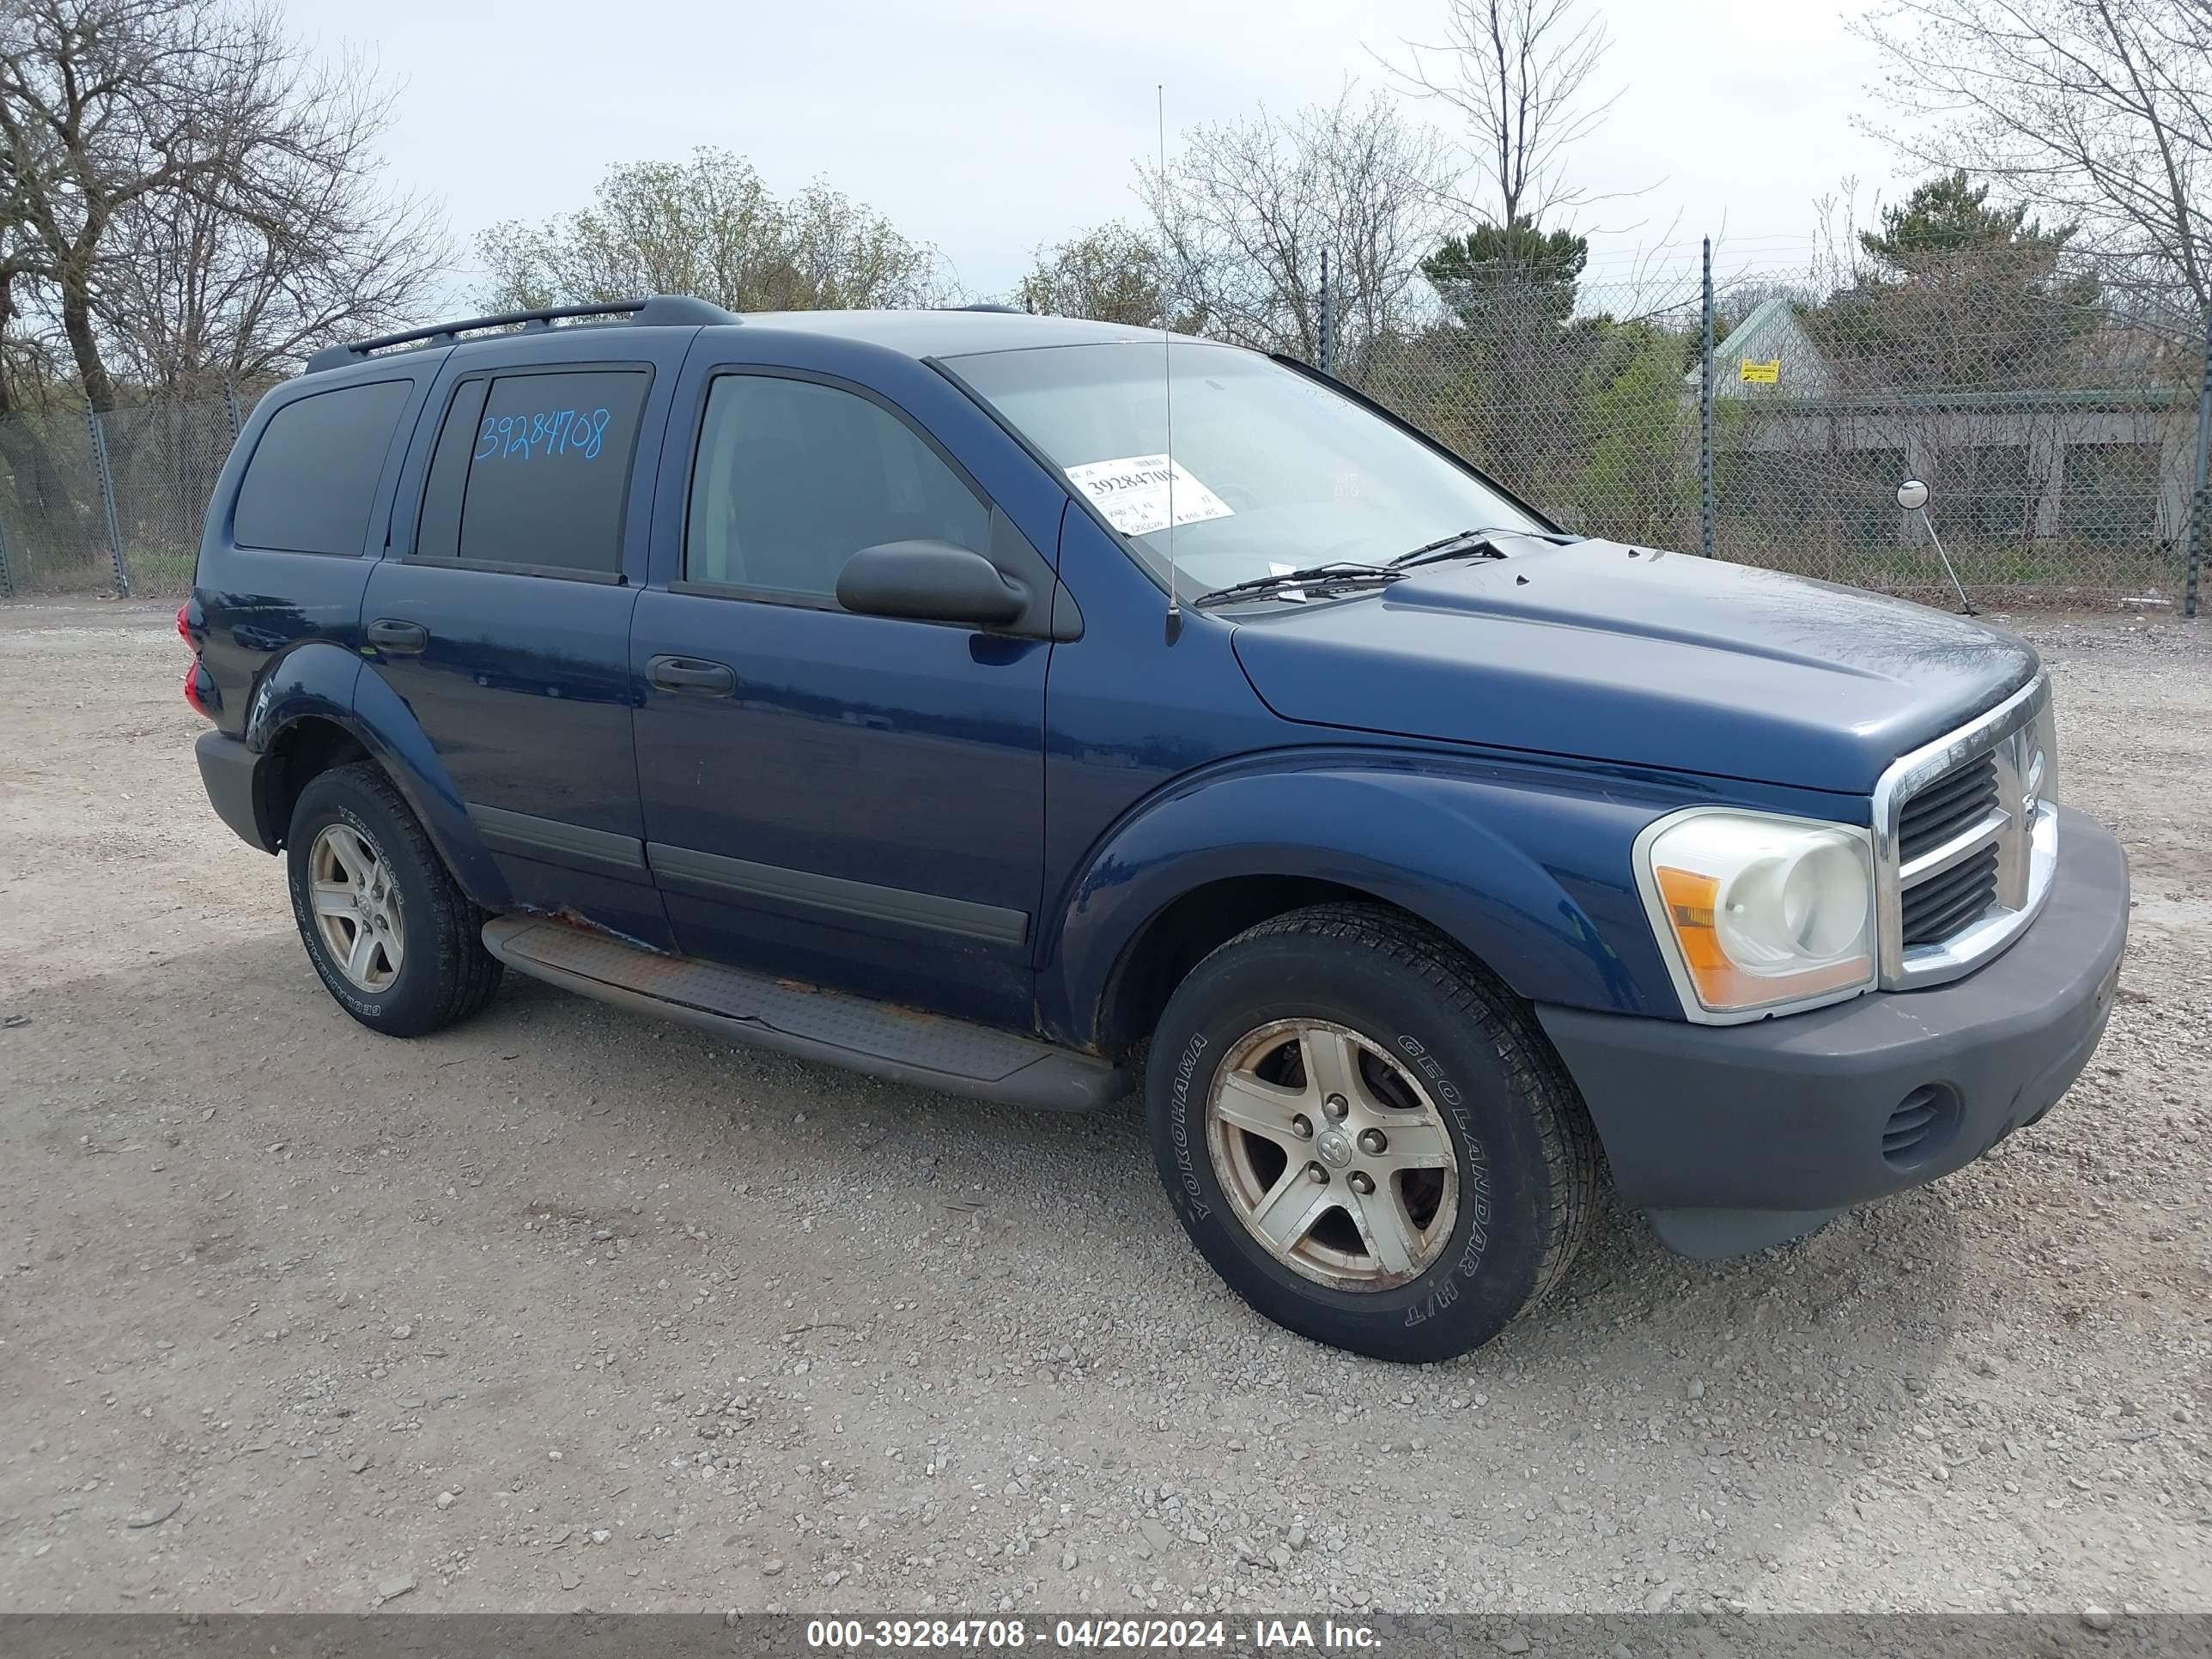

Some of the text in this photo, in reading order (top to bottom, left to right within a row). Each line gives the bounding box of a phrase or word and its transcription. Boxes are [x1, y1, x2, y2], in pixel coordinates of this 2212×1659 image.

[475, 408, 611, 460] 39284708
[1087, 468, 1180, 495] 39284708
[1169, 1032, 1211, 1222] YOKOHAMA
[1397, 1034, 1493, 1328] GEOLANDAR H/T
